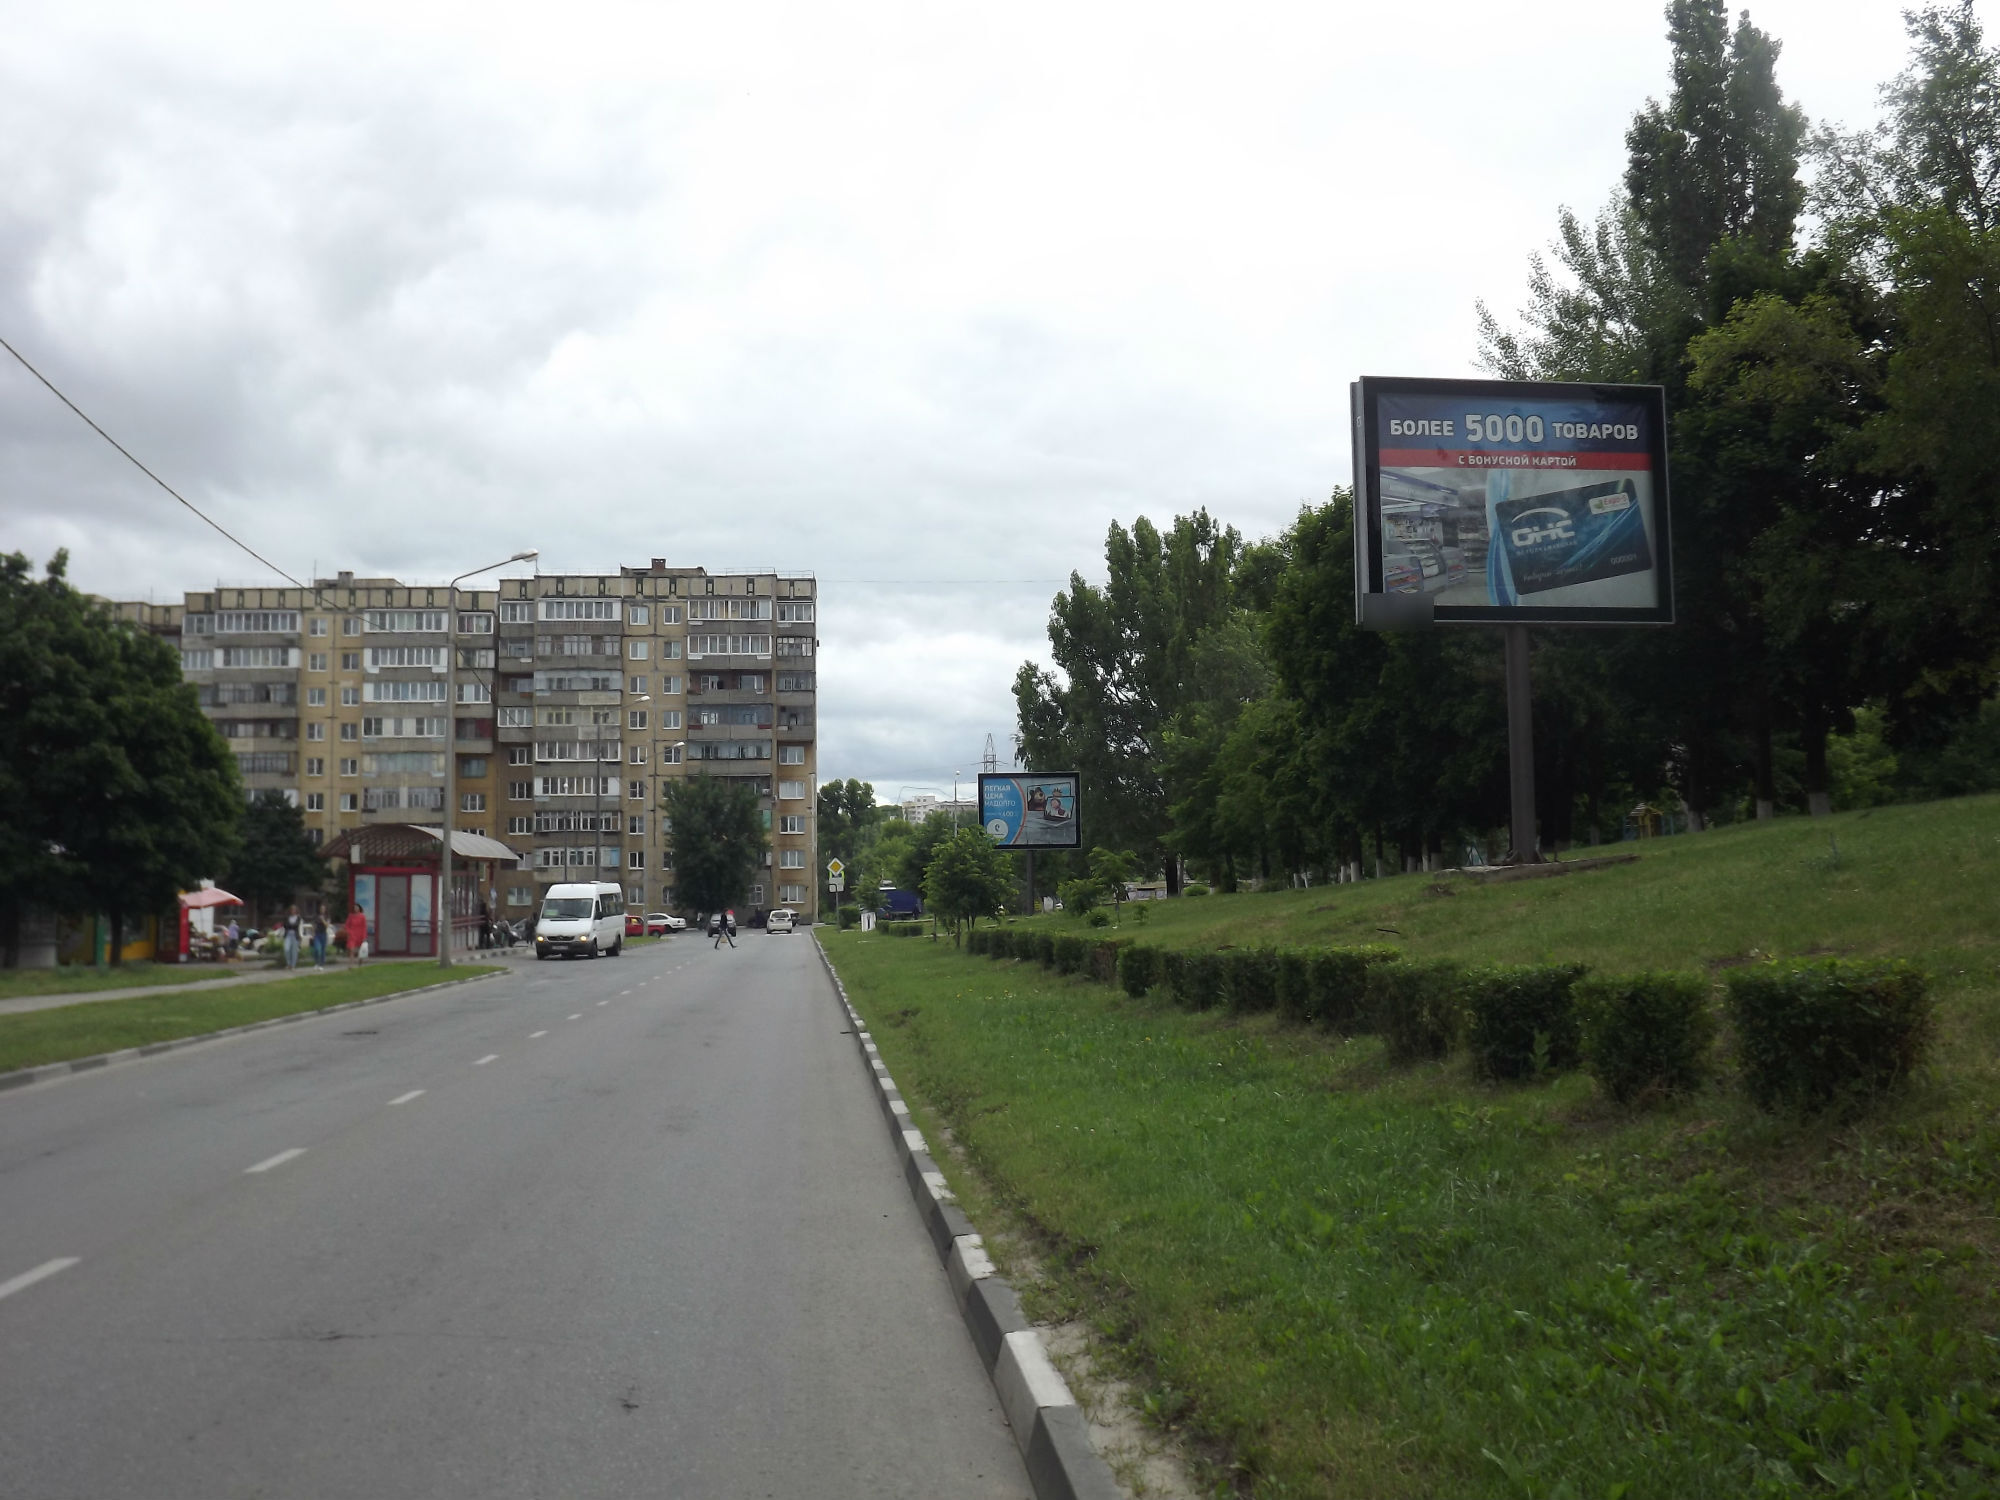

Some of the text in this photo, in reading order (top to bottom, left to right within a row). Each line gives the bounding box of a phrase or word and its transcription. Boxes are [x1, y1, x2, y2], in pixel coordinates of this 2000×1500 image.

[1390, 414, 1639, 443] БОЛЕЕ 5000 ТОВАРОВ
[1458, 454, 1577, 467] С БОНУСНОЙ КАРТОЙ
